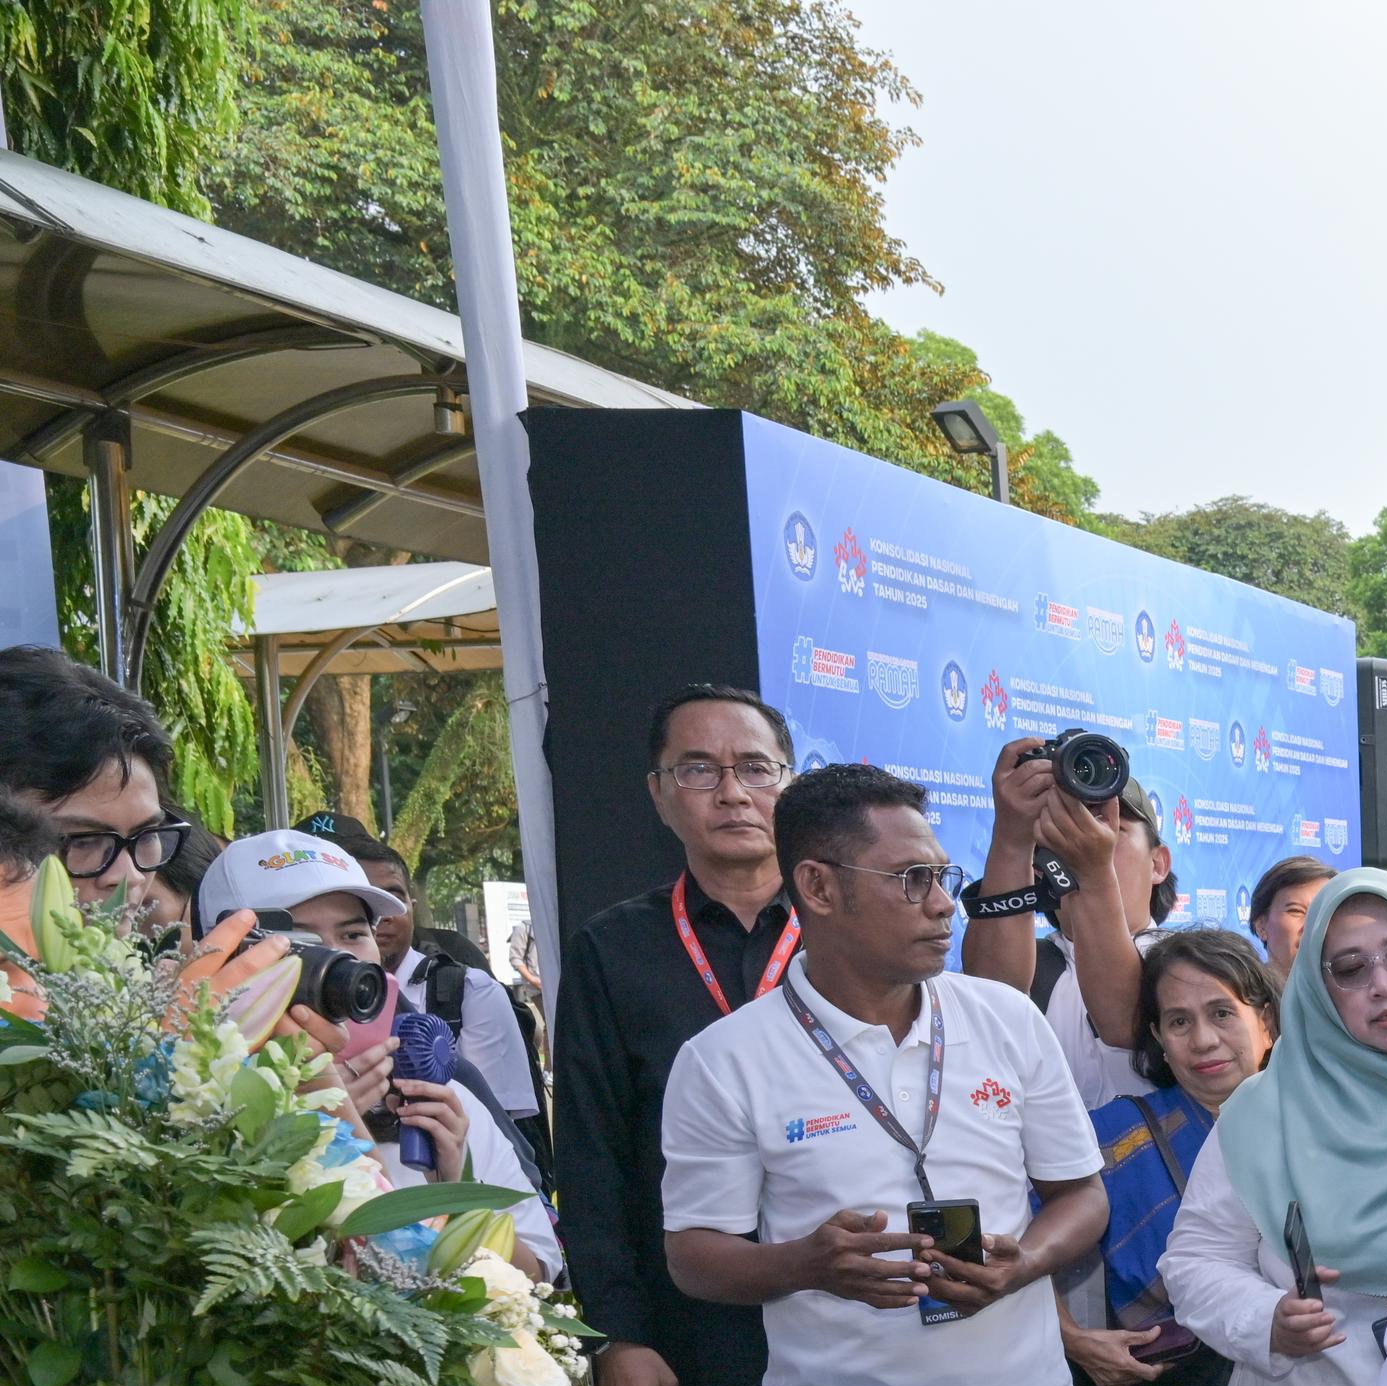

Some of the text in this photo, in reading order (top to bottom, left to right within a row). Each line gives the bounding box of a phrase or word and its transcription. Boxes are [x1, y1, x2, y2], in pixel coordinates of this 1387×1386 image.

[870, 538, 972, 579] KONSOLIDASI NASIONAL
[872, 561, 1018, 612] PENDIDIKAN DASAR DAN MENENGAH
[873, 583, 927, 608] TAHUN 2025
[814, 649, 854, 667] PENDIDIKAN
[813, 662, 845, 676] BERMUTU
[1010, 677, 1059, 696] KONSOLIDASI
[1012, 698, 1055, 716] PENDIDIKAN
[1057, 706, 1080, 719] DASAR
[1082, 710, 1095, 722] DAN
[1013, 717, 1057, 734] TAHUN 2025
[885, 764, 985, 787] KONSOLIDASI NASIONAL
[941, 793, 968, 806] DASAR
[970, 796, 987, 808] DAN
[979, 892, 1037, 913] SONY
[806, 1113, 850, 1126] PENDIDIKAN
[806, 1121, 840, 1132] BERMUTU
[806, 1124, 856, 1139] UNTUK SEMUA
